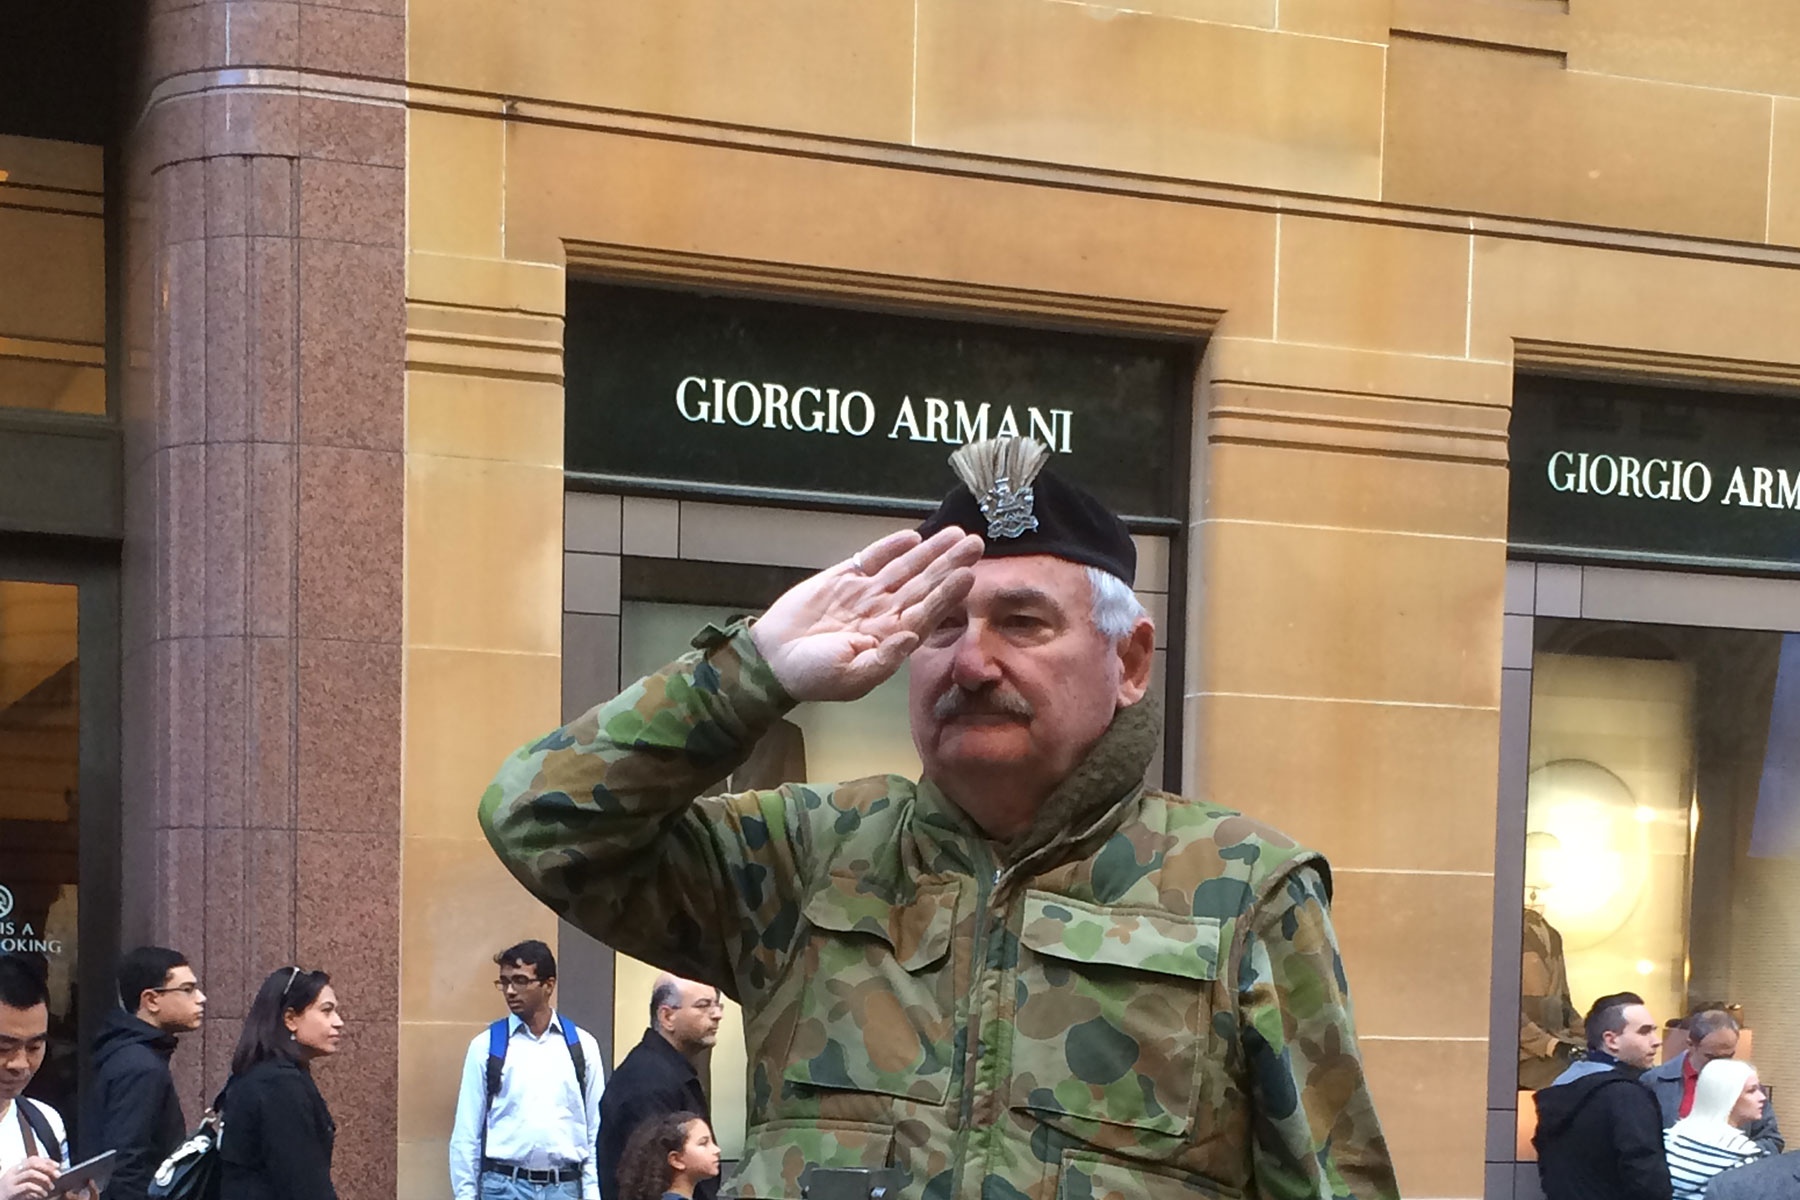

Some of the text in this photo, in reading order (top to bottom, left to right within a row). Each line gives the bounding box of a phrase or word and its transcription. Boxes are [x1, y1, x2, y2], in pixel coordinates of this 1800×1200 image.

[676, 377, 1073, 454] GIORGIO ARMANI
[1547, 451, 1712, 503] GIORGIO
[22, 922, 34, 936] A
